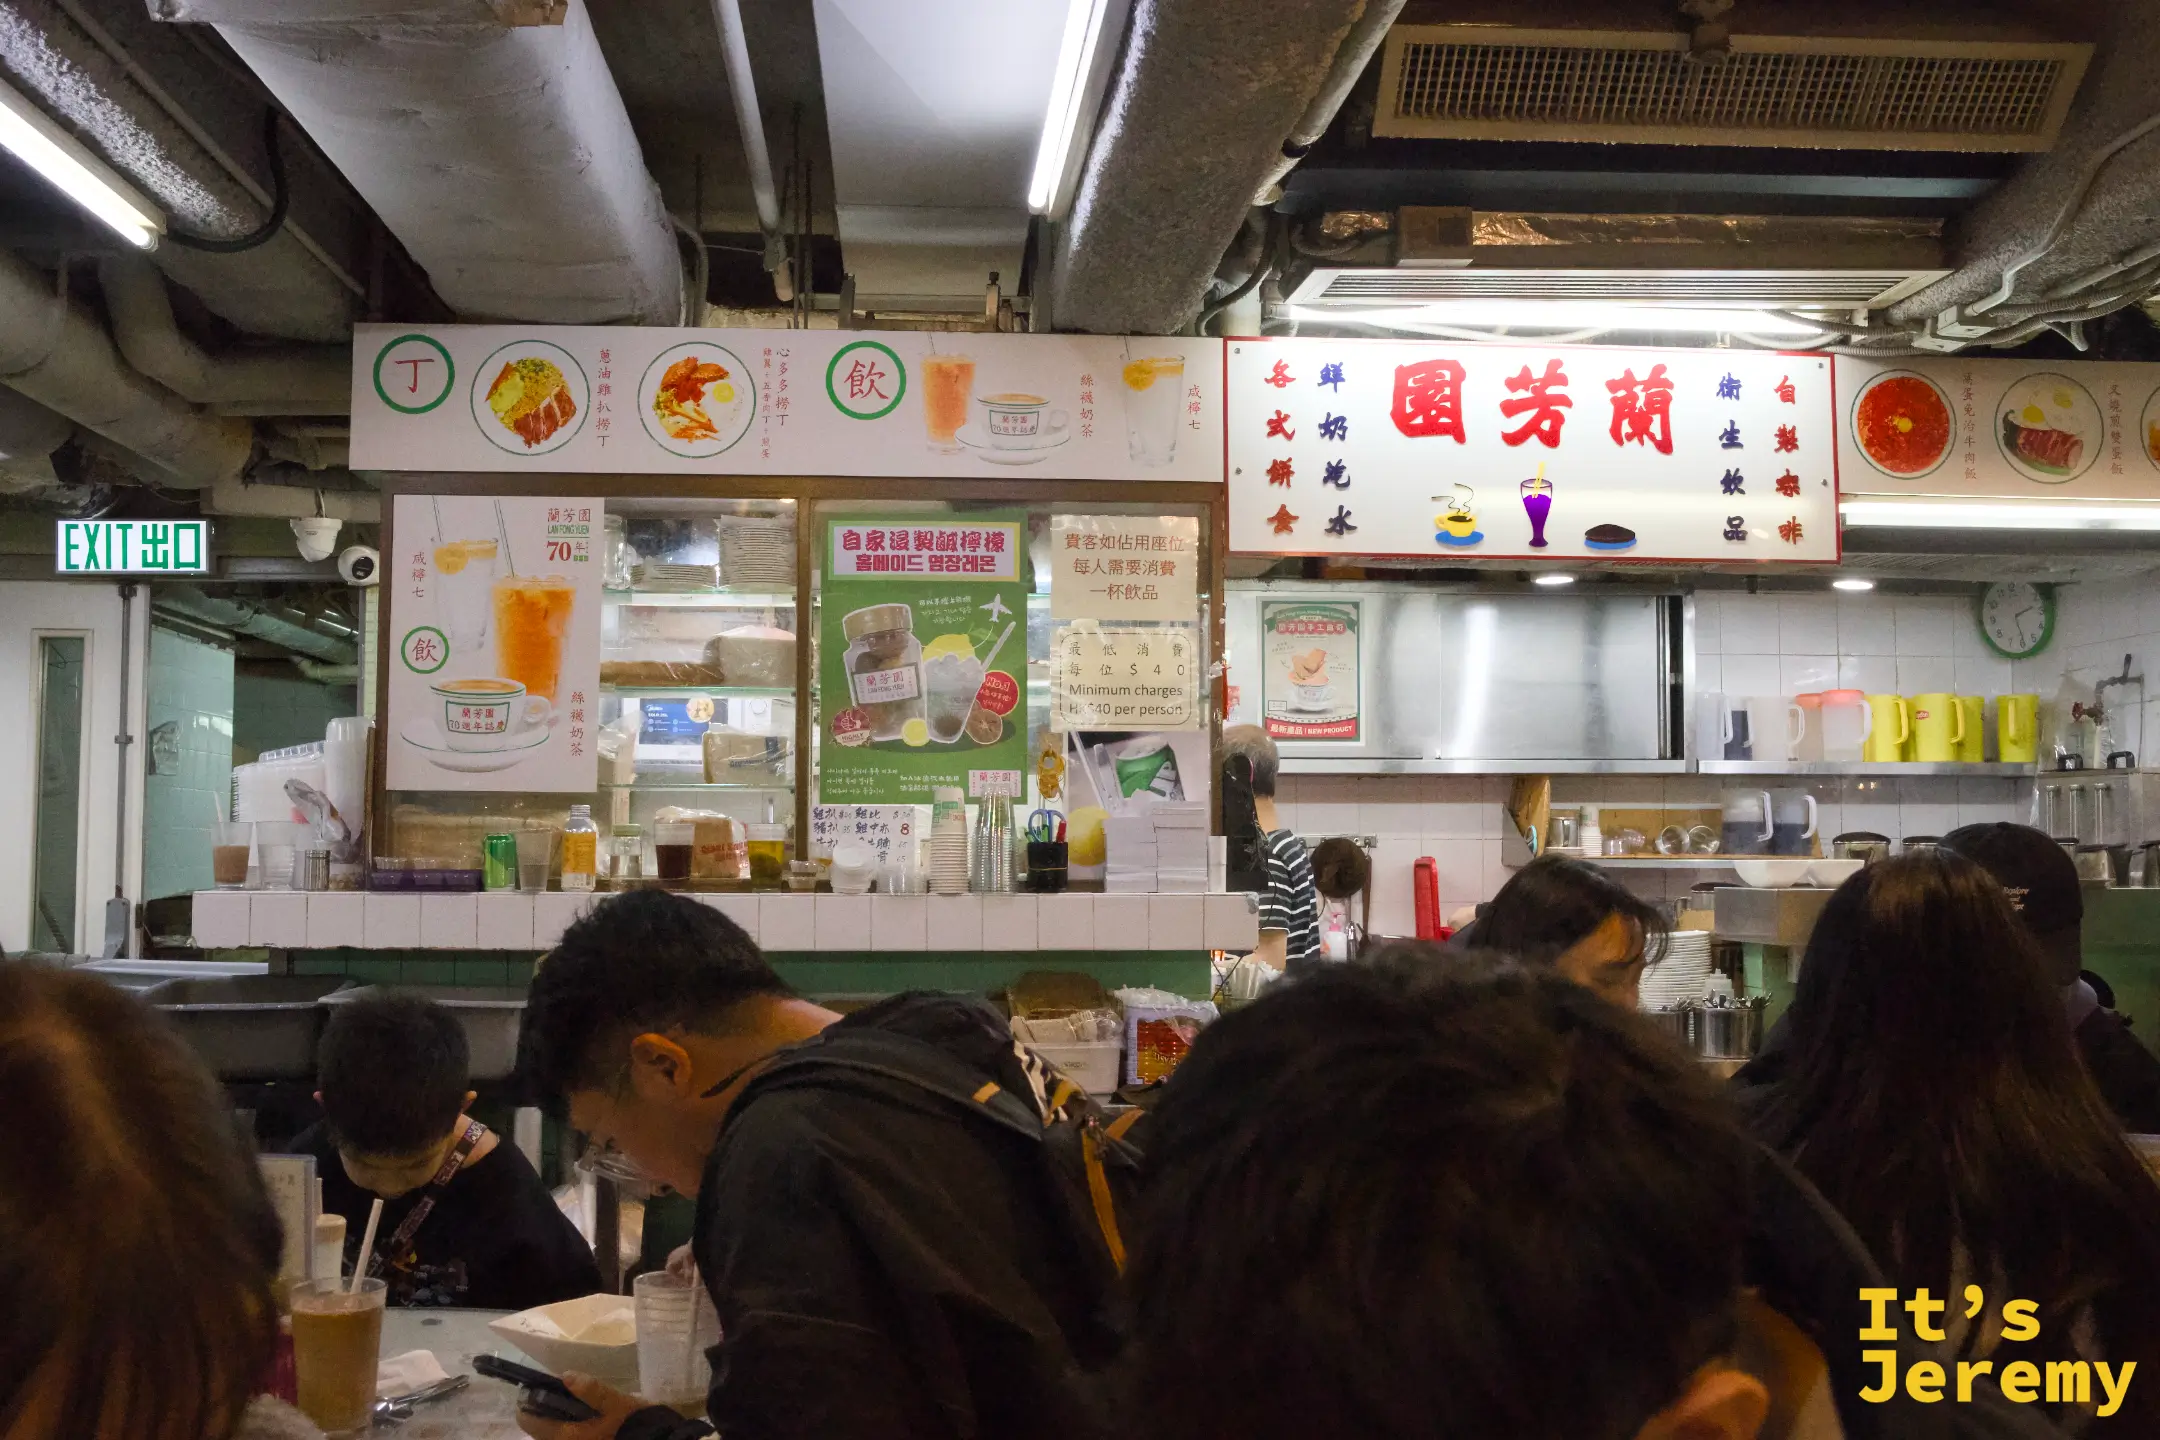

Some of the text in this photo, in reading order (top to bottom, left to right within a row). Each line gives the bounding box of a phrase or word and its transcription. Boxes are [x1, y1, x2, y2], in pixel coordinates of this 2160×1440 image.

[396, 358, 435, 393] 丁
[844, 359, 889, 400] 飲
[1080, 374, 1094, 439] 絲襪奶茶
[1188, 384, 1201, 431] 咸檸七
[1716, 372, 1747, 542] 衛生飲品
[547, 508, 591, 522] 蘭芳園
[65, 524, 133, 569] EXIT
[142, 524, 200, 569] 出口
[547, 541, 571, 561] 70
[1065, 533, 1185, 551] 貴客如佔用座位
[856, 554, 996, 573] 홈메이드 염장레몬
[1073, 558, 1176, 576] 每人需要消費
[412, 552, 426, 598] 咸檸七
[1090, 584, 1158, 600] 一杯飲品
[412, 638, 438, 662] 飲
[1068, 641, 1184, 658] 最低消費
[1069, 683, 1183, 698] Minimum charges
[462, 707, 494, 719] 蘭芳園
[1115, 705, 1136, 717] per
[1139, 705, 1182, 717] person
[570, 691, 585, 757] 絲襪奶茶
[979, 772, 1011, 782] 蘭芳園
[900, 823, 909, 835] 8
